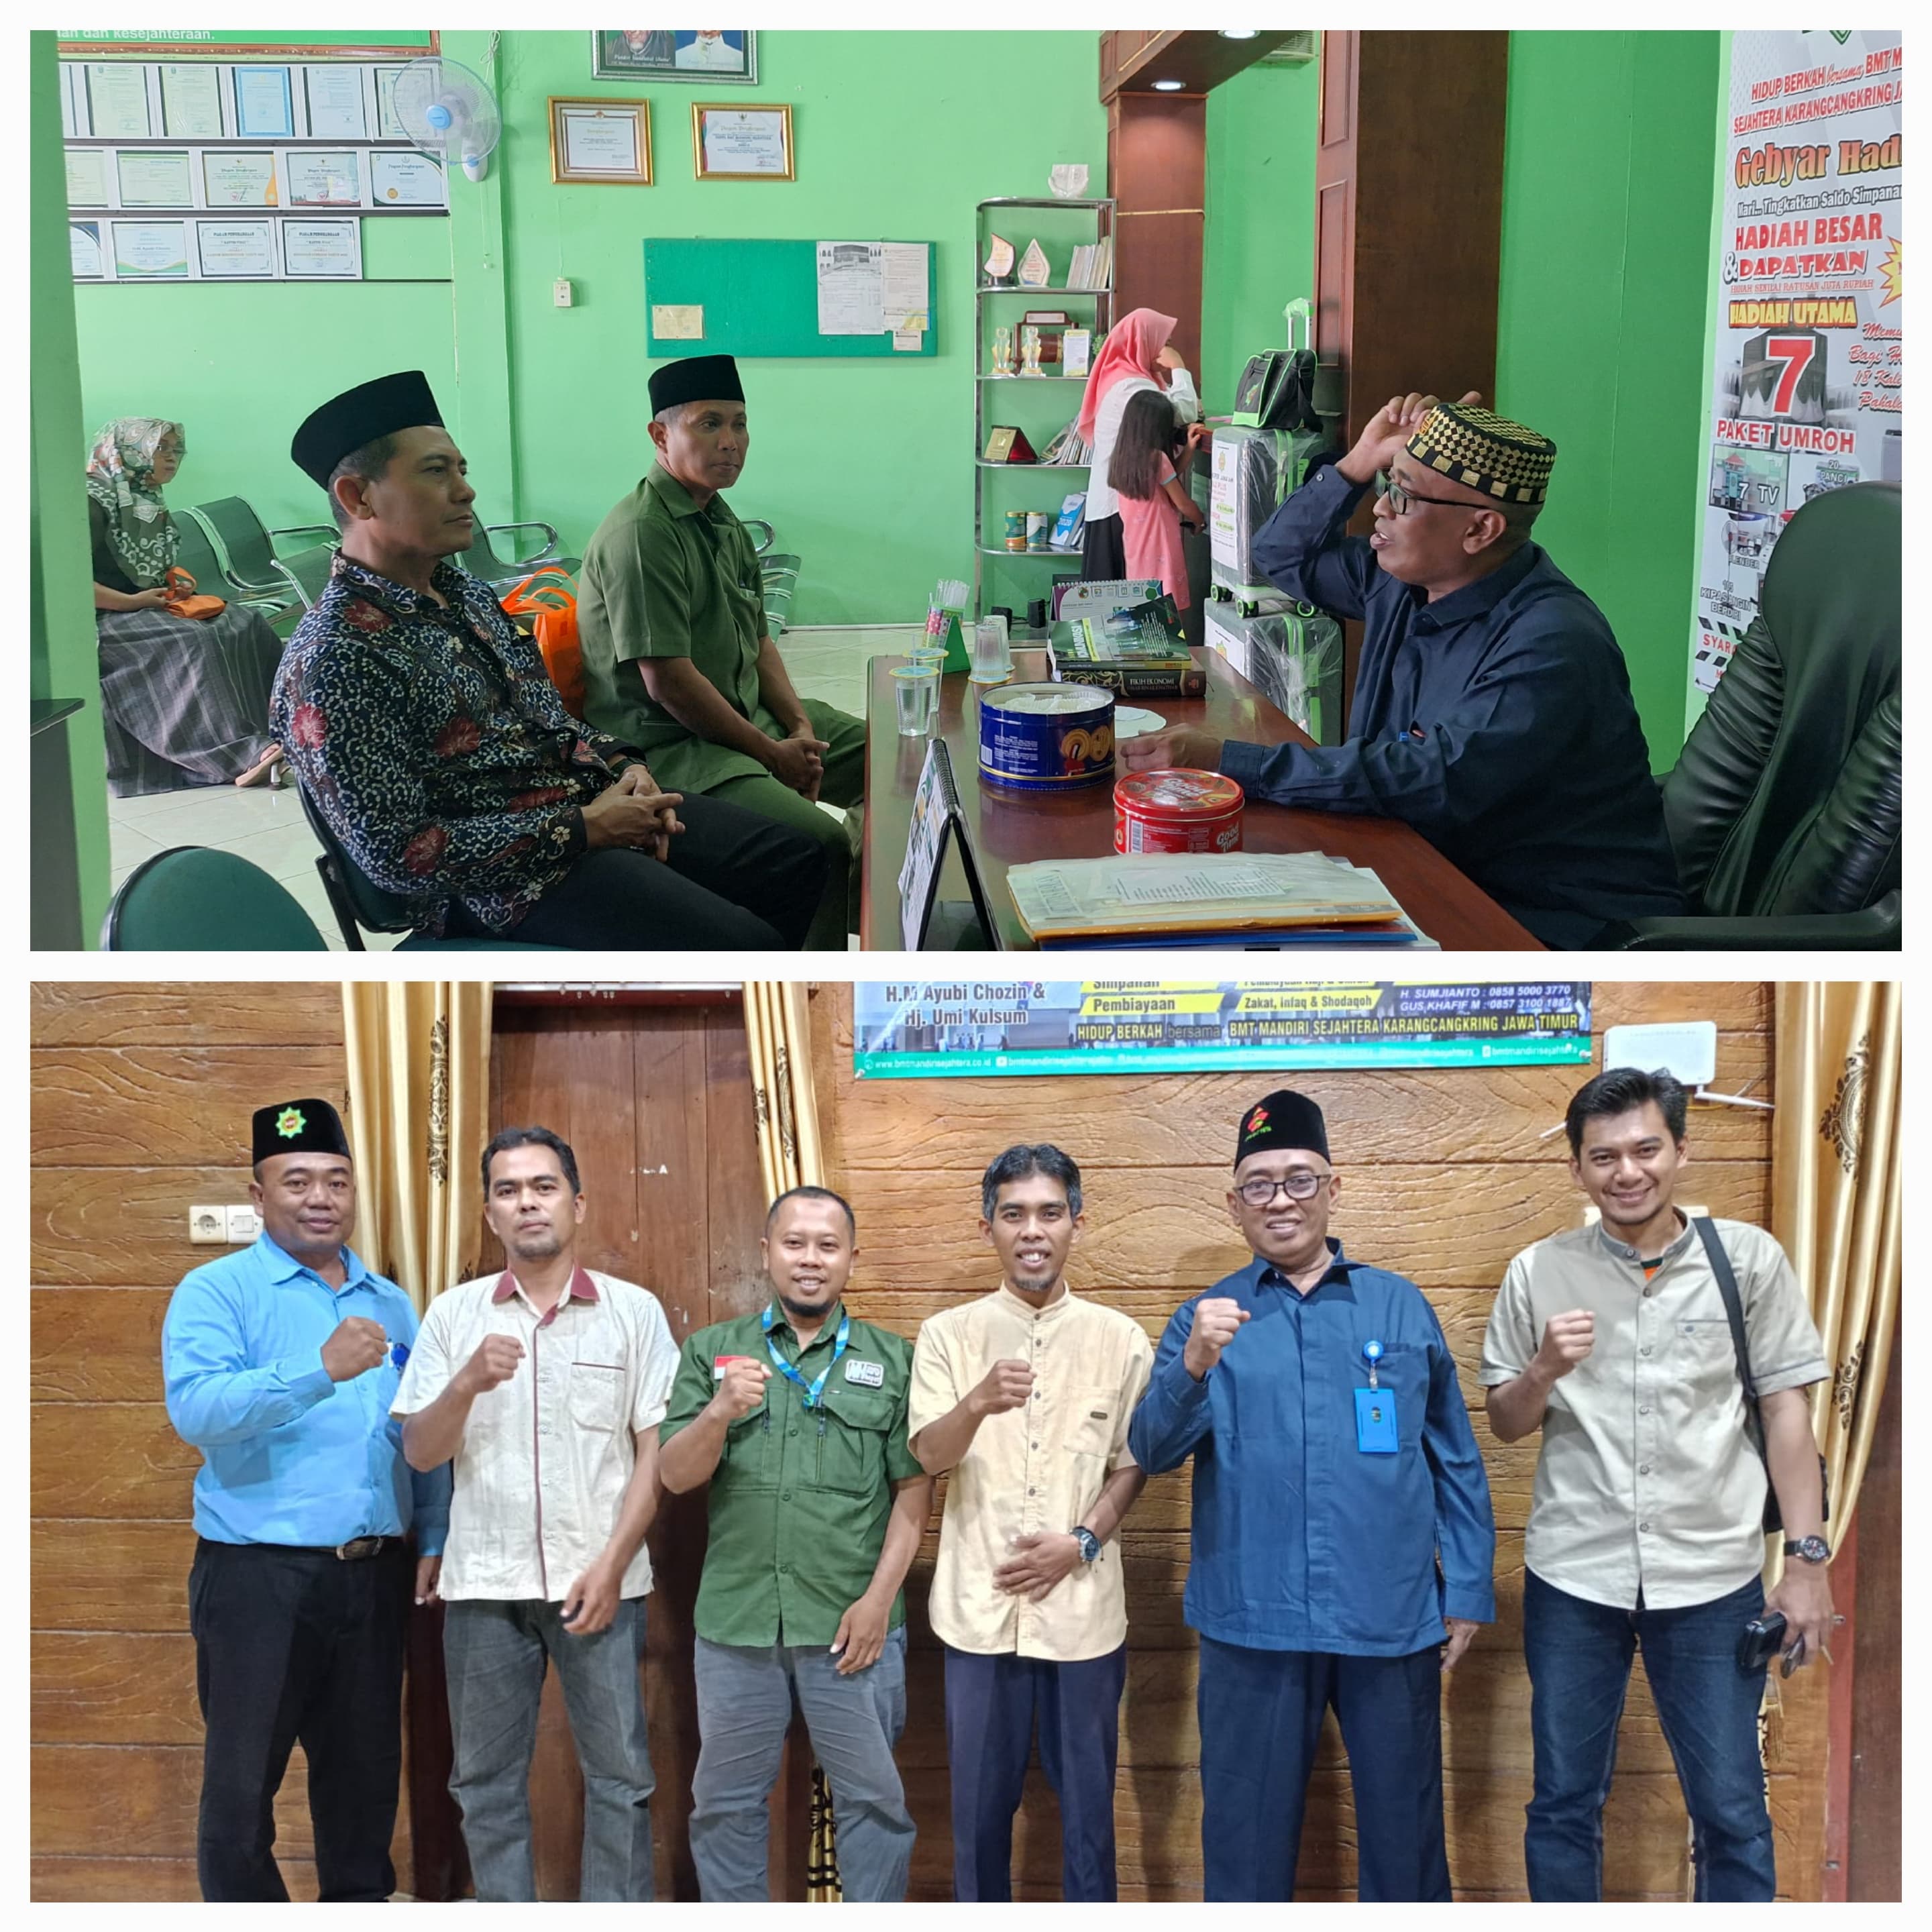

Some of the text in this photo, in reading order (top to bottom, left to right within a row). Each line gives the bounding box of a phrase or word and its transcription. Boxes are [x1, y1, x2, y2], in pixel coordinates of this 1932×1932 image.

[1752, 79, 1782, 101] HIDUP
[1784, 66, 1825, 93] BERKAH
[1827, 64, 1863, 83] bersama
[1866, 51, 1891, 74] BMT
[1734, 110, 1782, 134] SEJAHTERA
[1784, 83, 1891, 123] KARANGCANGKRING
[1735, 133, 1902, 188] Gebyar Had
[1764, 195, 1819, 216] Tingkatkan
[1821, 190, 1850, 208] Saldo
[1735, 213, 1882, 250] HADIAH BESAR
[1723, 252, 1738, 284] &
[1739, 250, 1868, 280] DAPATKAN
[1784, 282, 1819, 291] RATUSAN
[1821, 280, 1840, 290] JUTA
[1843, 279, 1874, 288] RUPIAH
[1729, 297, 1858, 327] HADIAH UTAMA
[1849, 344, 1882, 366] Bagi
[1767, 337, 1815, 416] 7
[1854, 370, 1872, 386] 18
[1717, 420, 1856, 453] PAKET UMROH
[1829, 460, 1839, 469] 20
[1738, 482, 1779, 504] 7 TV
[1700, 587, 1728, 602] KIPAS
[1147, 678, 1174, 686] EKONOMI
[1216, 822, 1239, 845] Good
[924, 984, 967, 1004] Ayubi
[974, 983, 1026, 1000] Chozin
[1033, 983, 1045, 998] &
[1245, 997, 1277, 1009] Zakat,
[1311, 996, 1318, 1007] &
[1322, 995, 1372, 1009] Shodaqoh
[1415, 987, 1480, 998] SUMJIANTO
[1489, 986, 1514, 997] 0858
[1517, 985, 1542, 996] 5000
[1546, 985, 1570, 995] 3770
[1093, 998, 1175, 1012] Pembiayaan
[1471, 1000, 1481, 1009] M
[1490, 999, 1515, 1009] 0857
[1518, 998, 1543, 1008] 3100
[1547, 997, 1571, 1007] 1887
[906, 1008, 1026, 1027] Hj. Umi Kulsum
[1078, 1014, 1578, 1039] HIDUP BERKAH bersama BMT MANDIRI SEJAHTERA KARANGCANGKRING JAWA TIMUR
